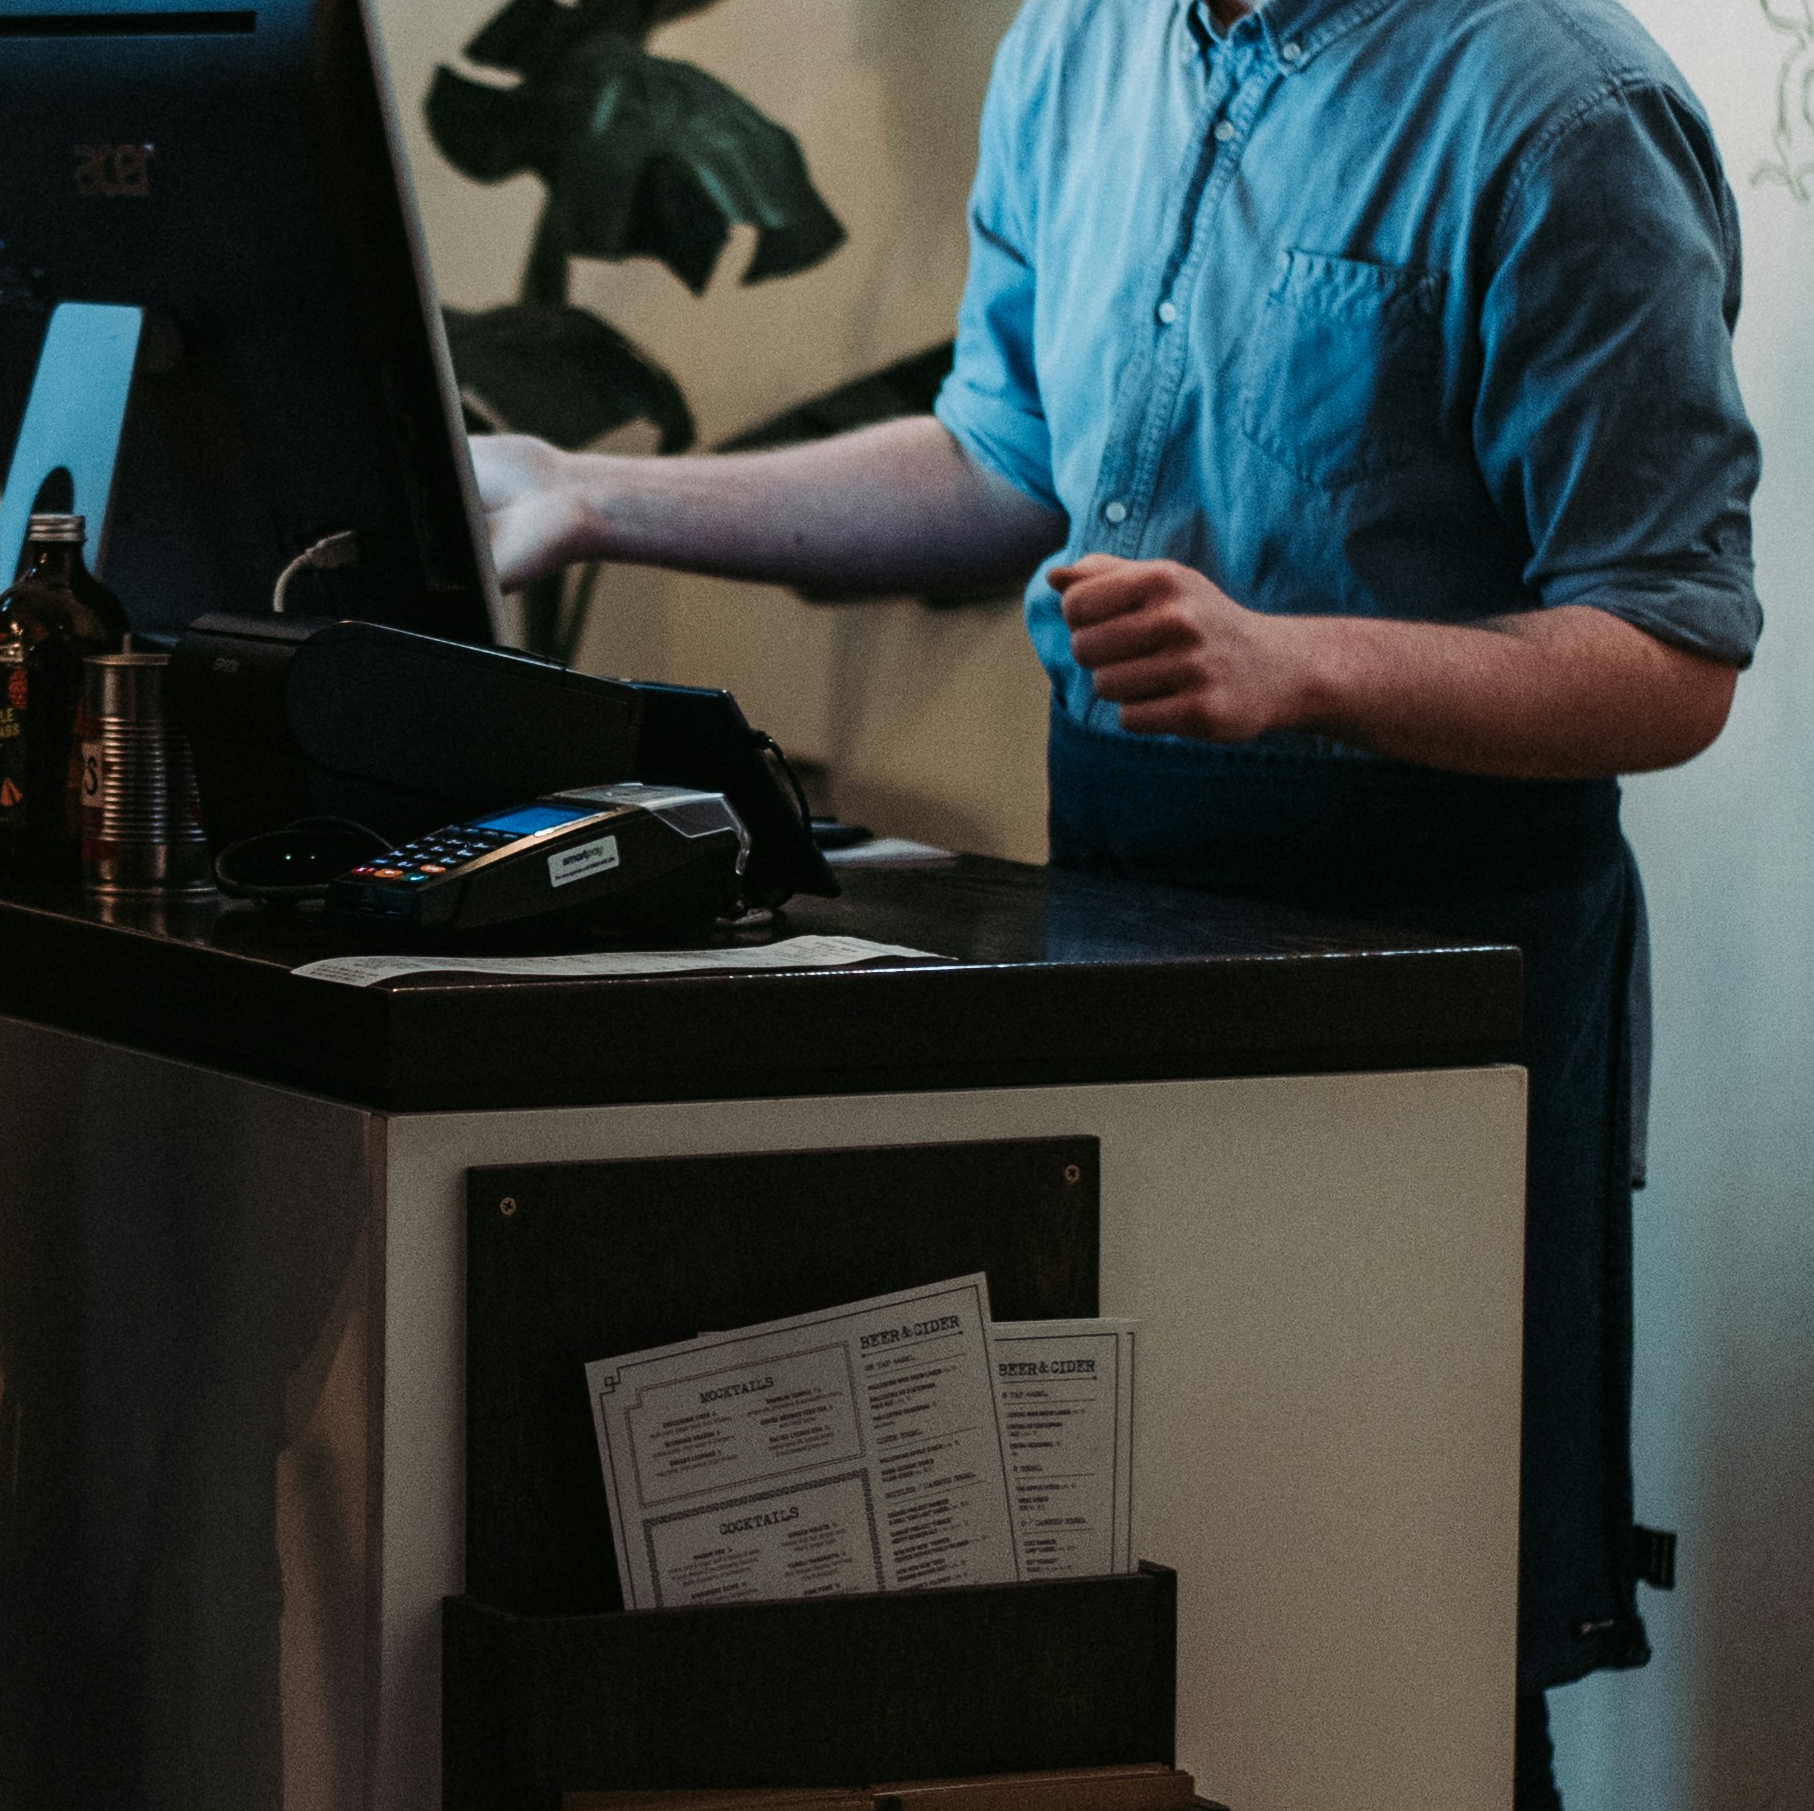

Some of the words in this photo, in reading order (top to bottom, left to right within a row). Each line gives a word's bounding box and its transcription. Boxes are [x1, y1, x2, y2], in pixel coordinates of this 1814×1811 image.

[860, 1328, 901, 1350] BEER
[901, 1325, 913, 1339] &
[913, 1315, 961, 1337] CIDER
[999, 1362, 1037, 1377] BEER
[1038, 1361, 1048, 1374] &
[1050, 1359, 1096, 1374] CIDER
[699, 1376, 775, 1404] MOCKTAILS
[719, 1506, 800, 1536] COCKTAILS
